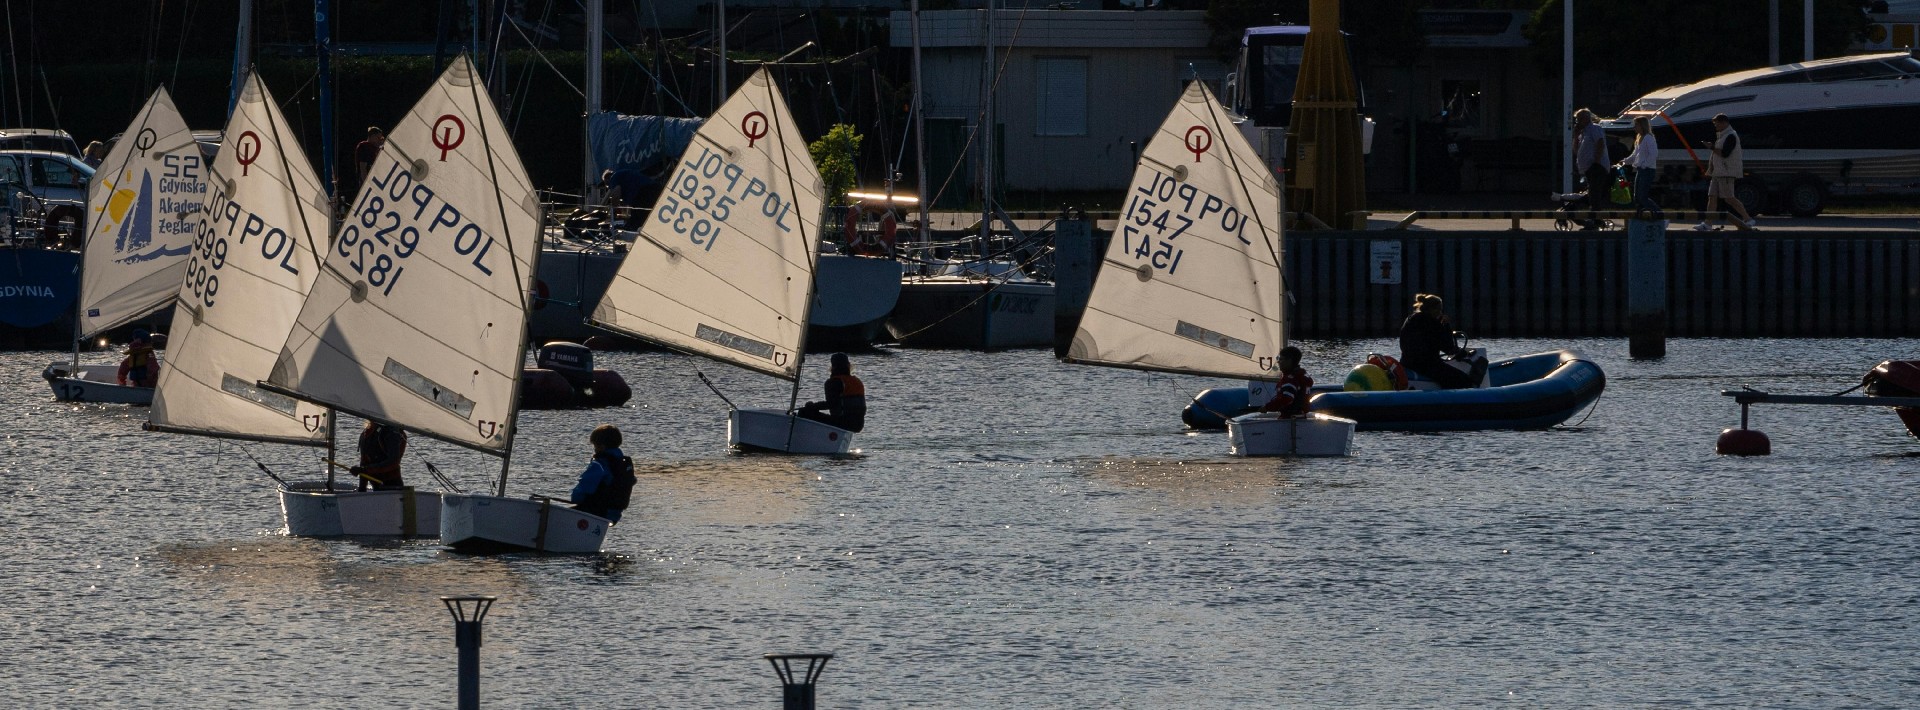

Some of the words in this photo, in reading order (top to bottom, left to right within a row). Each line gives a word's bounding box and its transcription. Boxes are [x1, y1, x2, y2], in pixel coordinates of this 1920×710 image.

[159, 178, 206, 194] Gdyńska
[164, 155, 199, 178] 52
[670, 168, 736, 221] 1935
[740, 176, 791, 233] POL
[1126, 194, 1194, 241] 1547
[1198, 194, 1251, 246] POL
[194, 218, 228, 270] 999
[239, 213, 299, 276] POL
[354, 187, 419, 259] 1829
[428, 202, 494, 277] POL
[60, 384, 85, 401] 12
